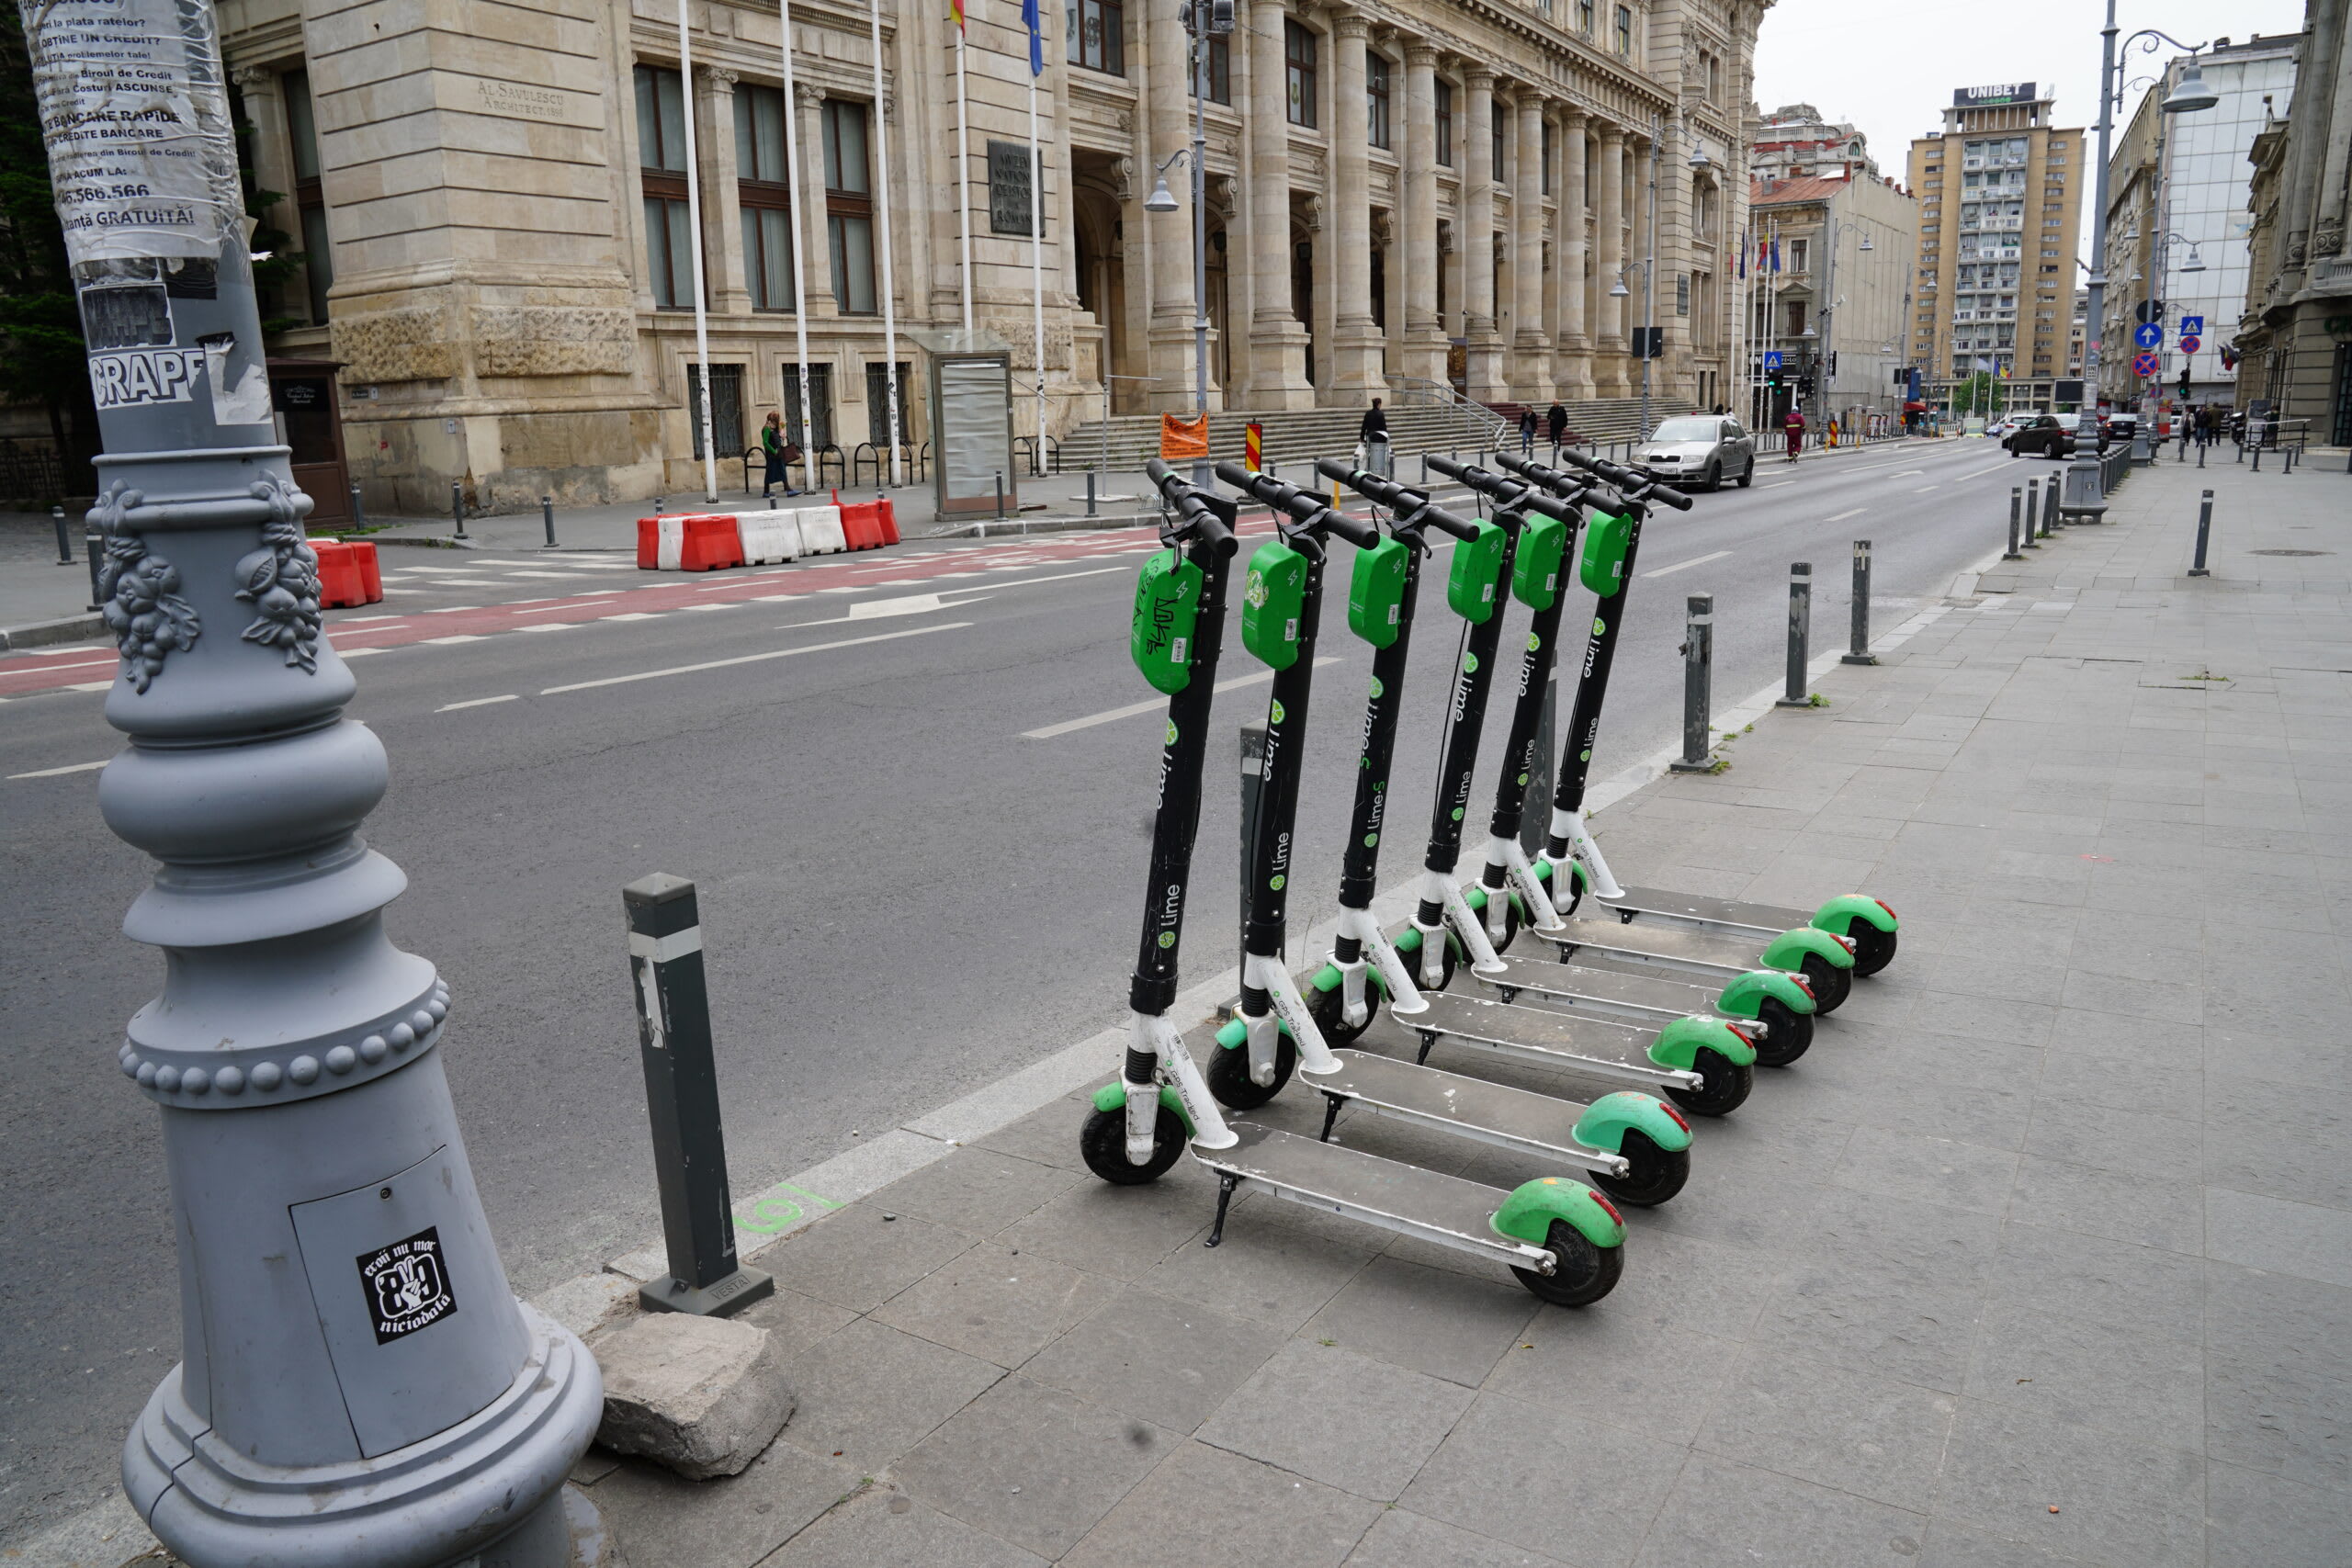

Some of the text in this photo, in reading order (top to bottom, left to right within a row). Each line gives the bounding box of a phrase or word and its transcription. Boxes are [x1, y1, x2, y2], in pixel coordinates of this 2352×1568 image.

[54, 19, 62, 28] la
[66, 18, 95, 28] plata
[98, 17, 146, 28] ratelor?
[81, 69, 115, 78] Biroul
[118, 69, 133, 78] de
[136, 69, 173, 80] Credit
[116, 83, 174, 94] ASCUNSE
[1968, 83, 2023, 99] UNIBET
[62, 97, 86, 107] Credit
[100, 129, 164, 139] BANCARE
[100, 150, 116, 158] din
[117, 148, 148, 157] Biroul
[150, 148, 163, 156] de
[74, 167, 104, 179] ACUM
[107, 166, 128, 176] LA:
[1583, 637, 1601, 679] Lime
[1520, 655, 1536, 697] Lime
[1454, 677, 1474, 722] Lime
[1584, 717, 1600, 748] Lime
[1521, 739, 1536, 771] Lime
[1455, 771, 1472, 805] Lime
[1272, 831, 1290, 872] Lime
[1160, 884, 1182, 927] Lime
[1279, 1000, 1306, 1047] GPS Tracked
[1170, 1070, 1201, 1121] GPS Tracked
[393, 1243, 410, 1258] nu
[413, 1240, 435, 1252] mor
[711, 1278, 749, 1300] VESTA
